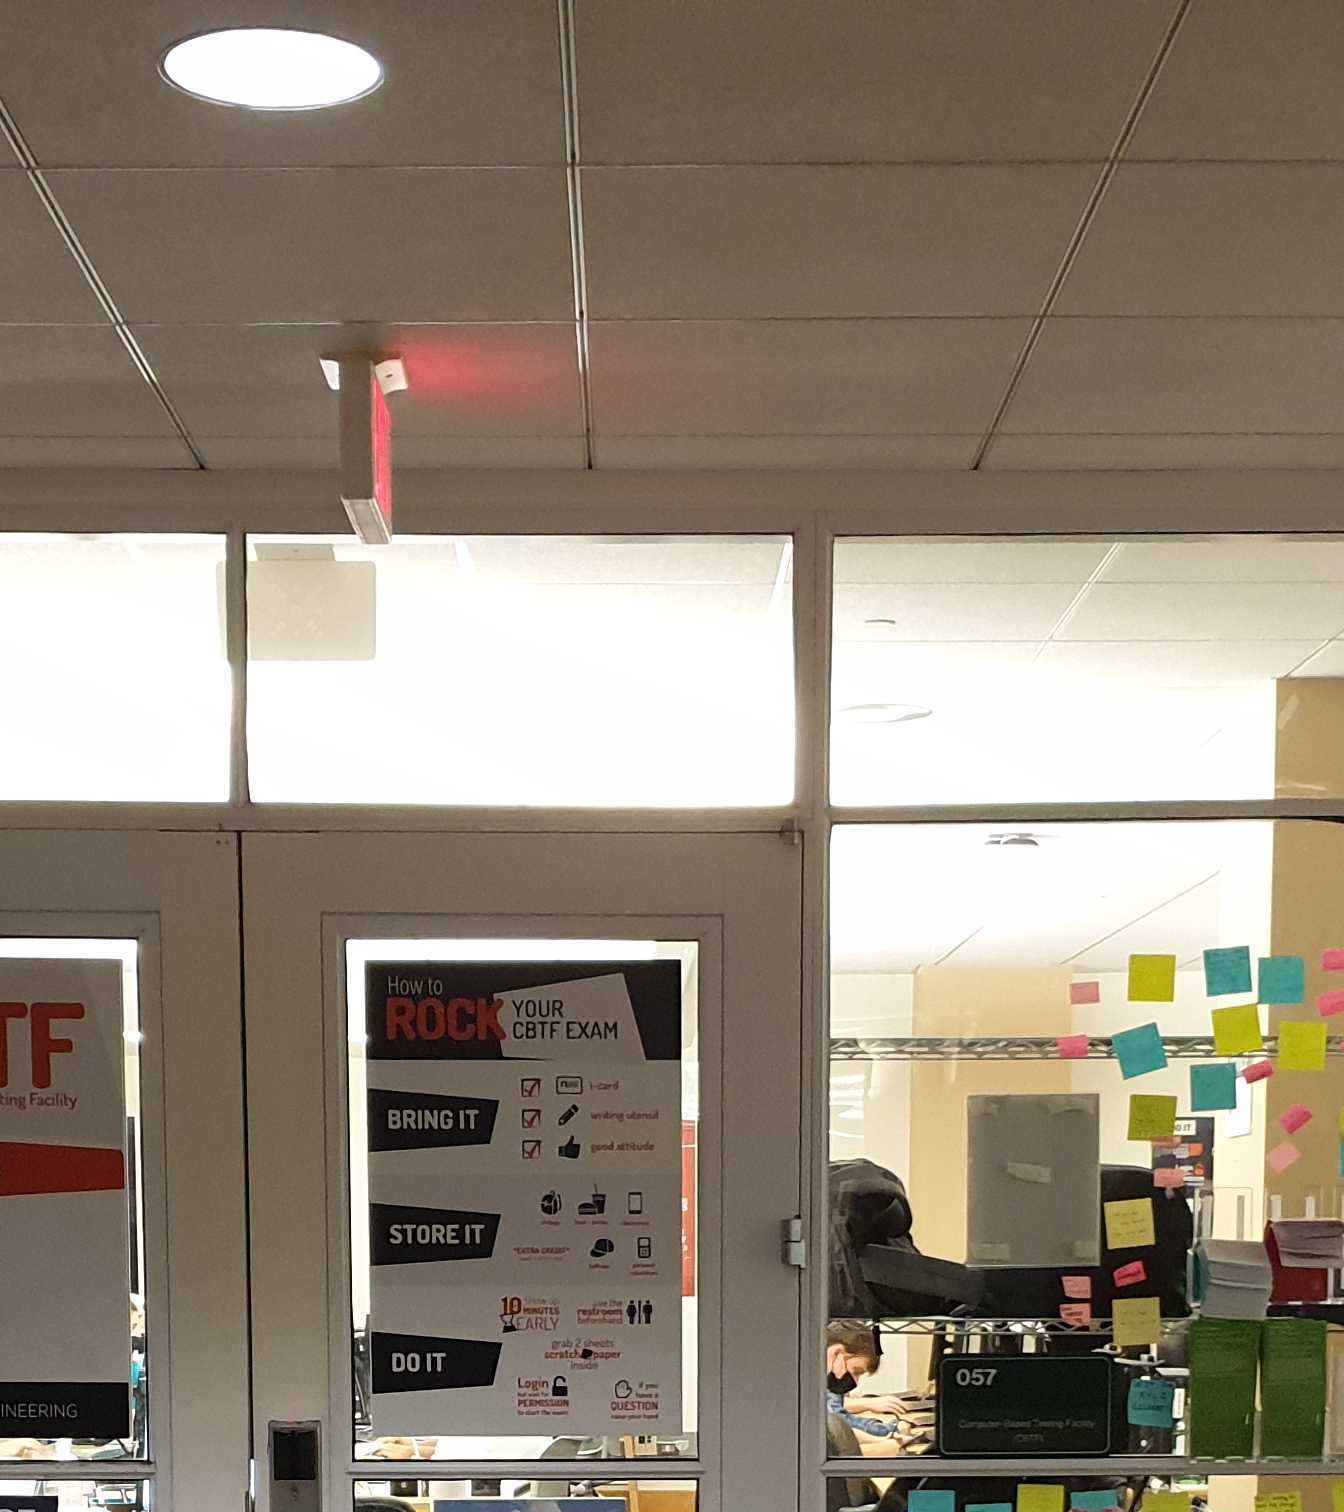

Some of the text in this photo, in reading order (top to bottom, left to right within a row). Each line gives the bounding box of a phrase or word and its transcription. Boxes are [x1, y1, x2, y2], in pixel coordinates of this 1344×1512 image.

[387, 975, 443, 995] How to
[386, 997, 564, 1041] ROCK YOUR
[512, 1020, 618, 1040] CBTF EXAM
[29, 1092, 77, 1110] Facility
[387, 1109, 479, 1130] BRING IT
[389, 1224, 485, 1245] STORE IT
[501, 1296, 522, 1314] 10
[516, 1317, 560, 1331] EARLY
[391, 1352, 446, 1373] DO IT
[518, 1377, 549, 1390] Login
[956, 1368, 997, 1386] 057
[611, 1400, 658, 1411] QUESTION
